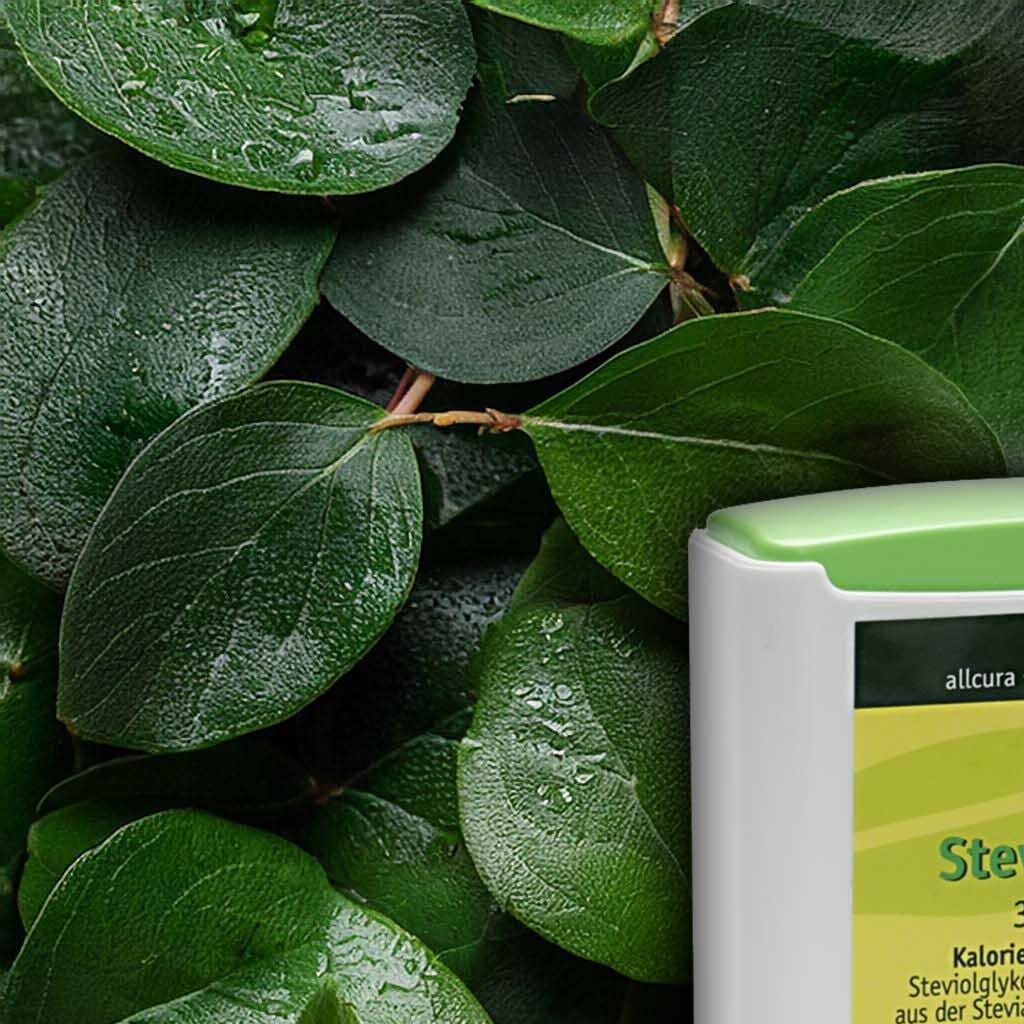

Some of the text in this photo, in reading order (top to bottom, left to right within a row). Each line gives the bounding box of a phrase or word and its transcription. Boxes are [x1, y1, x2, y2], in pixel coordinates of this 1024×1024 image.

[945, 668, 1015, 690] allcura
[895, 1006, 928, 1024] aus
[935, 999, 966, 1022] der
